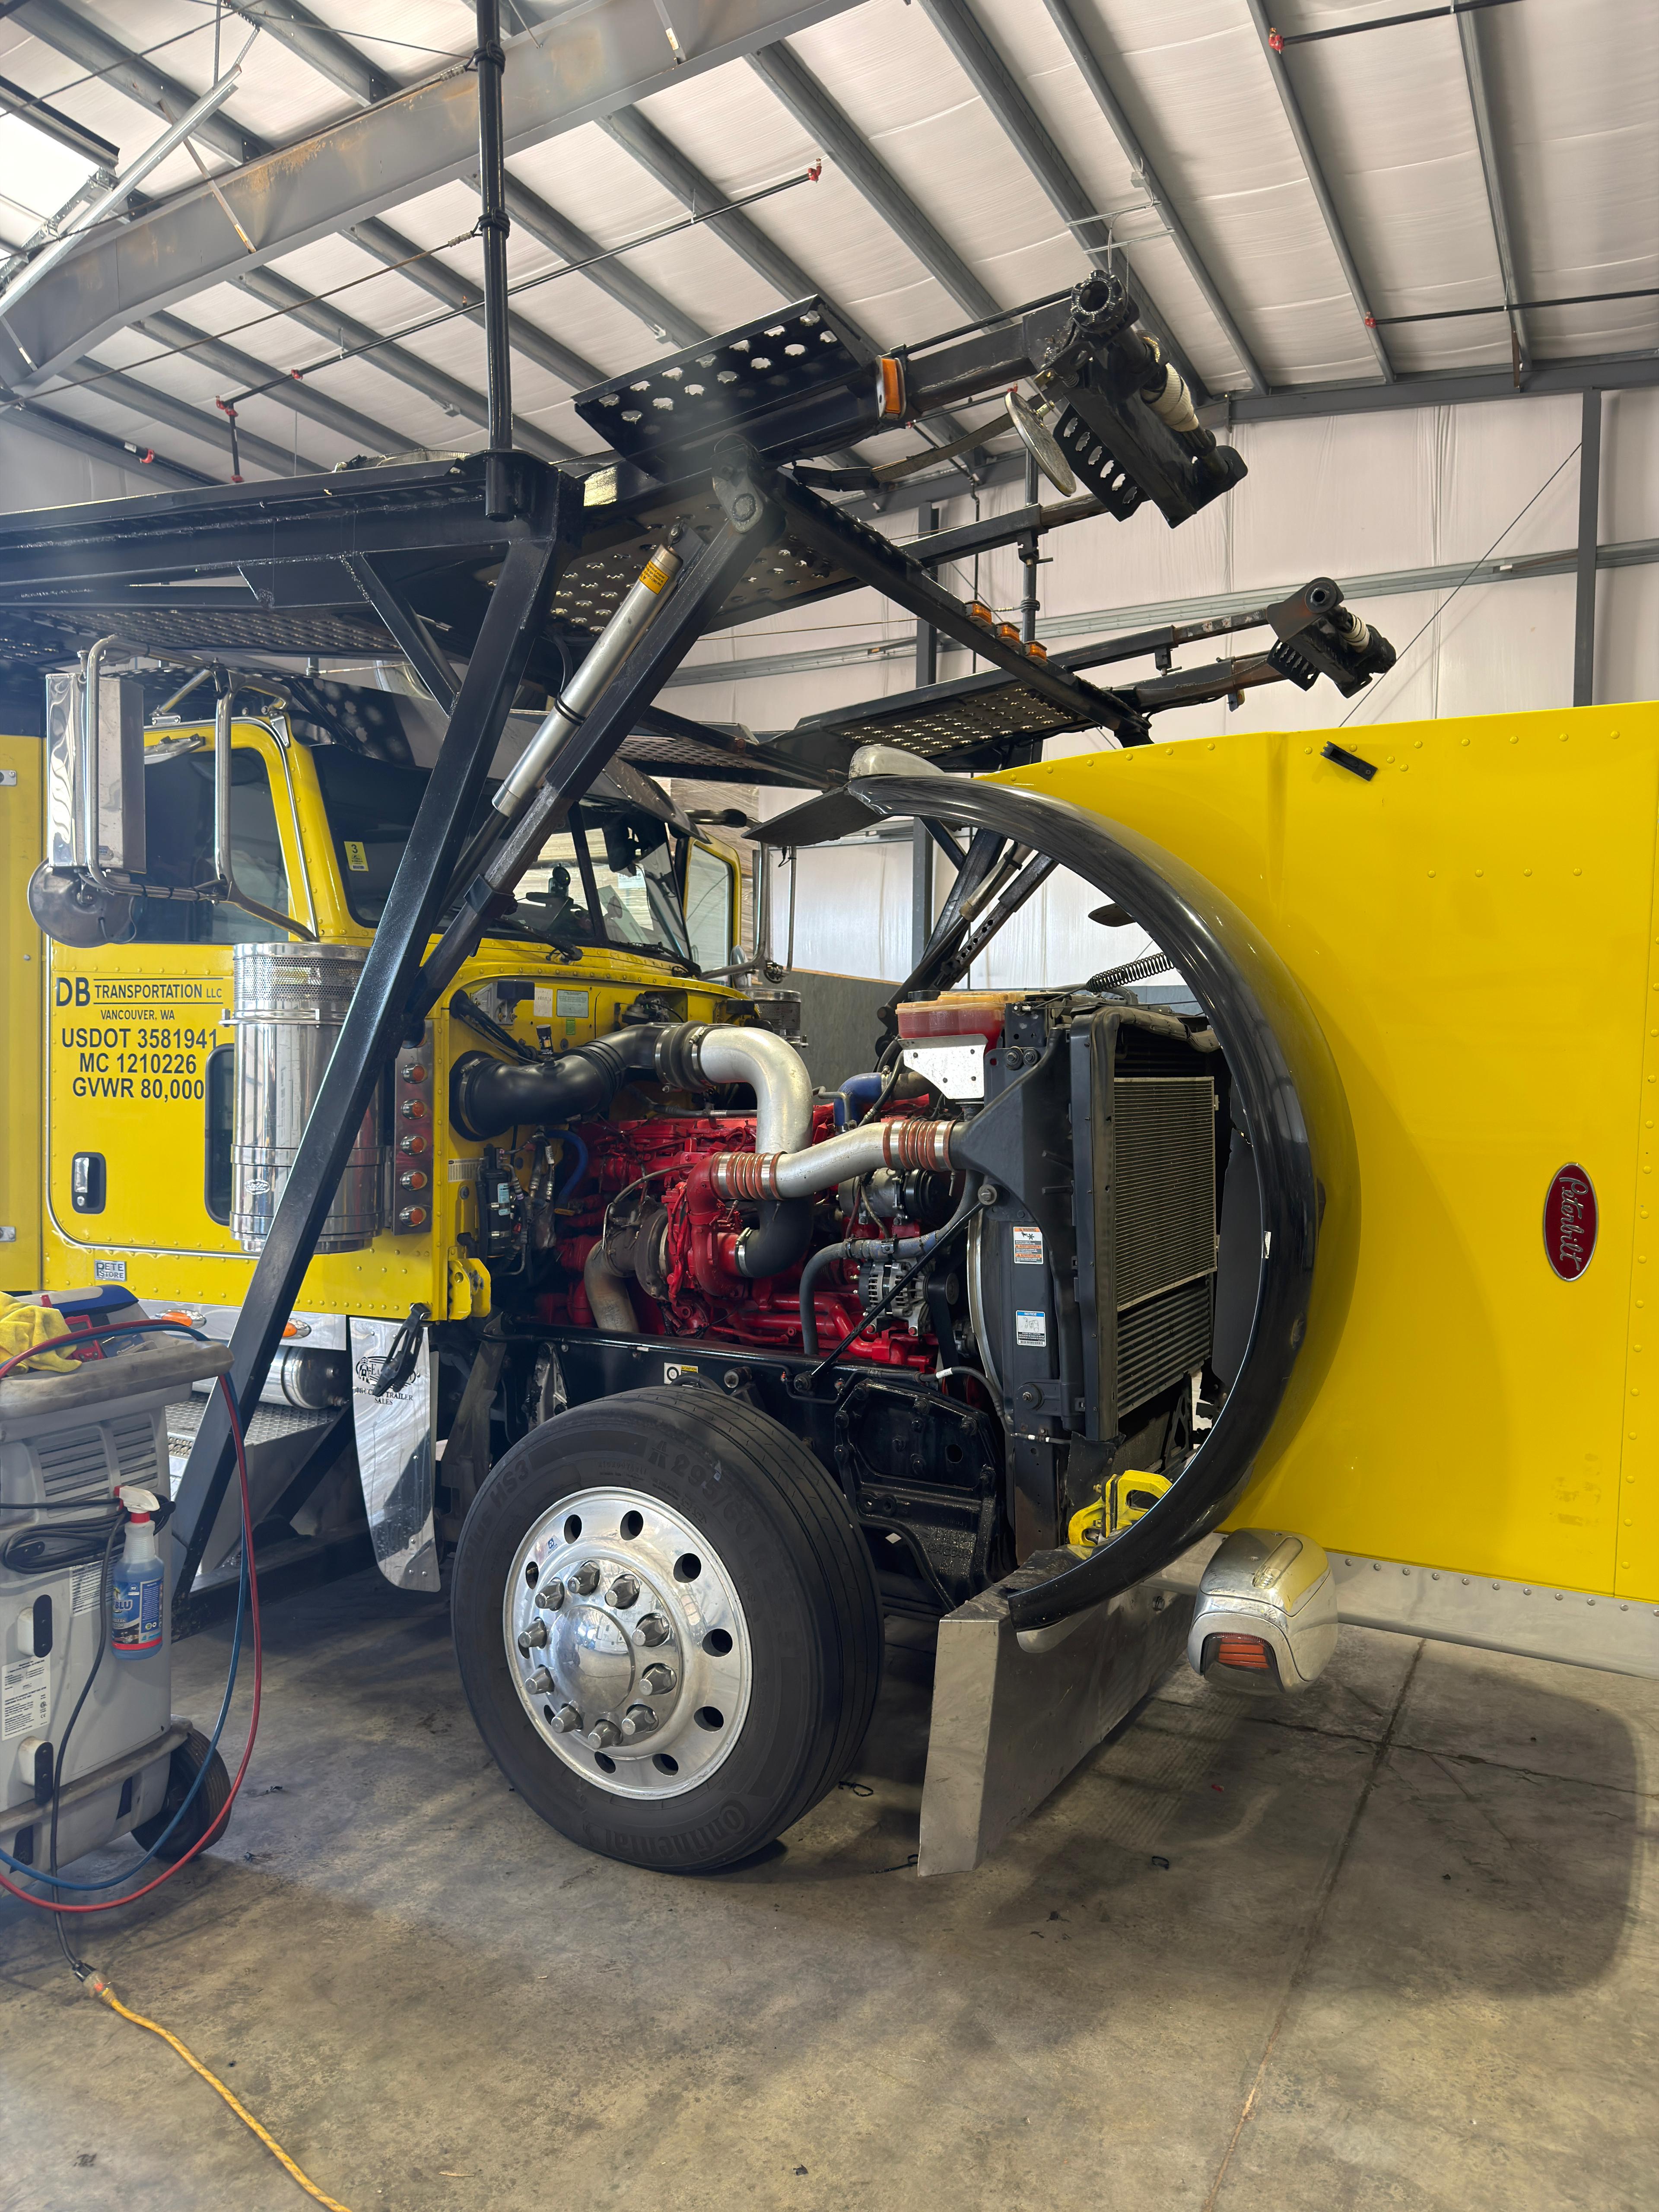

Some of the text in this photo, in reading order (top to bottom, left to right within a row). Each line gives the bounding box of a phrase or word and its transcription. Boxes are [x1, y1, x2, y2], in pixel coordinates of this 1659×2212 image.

[351, 844, 358, 853] 3
[56, 977, 222, 1007] DB TRANSPORTATION LLC
[101, 1010, 175, 1021] VANCOUVER, WA
[62, 1028, 217, 1049] USDOT 3581941
[79, 1053, 197, 1074] MC 1210226
[73, 1077, 204, 1102] GVWR 80,000
[1559, 1177, 1589, 1271] Peterbilt
[96, 1262, 124, 1276] PETE
[99, 1270, 124, 1278] STORE
[375, 1397, 393, 1405] SALES
[386, 1391, 413, 1401] TRAILER
[490, 1459, 530, 1509] HS3
[114, 1600, 132, 1611] BLU
[605, 1799, 752, 1859] Continental
